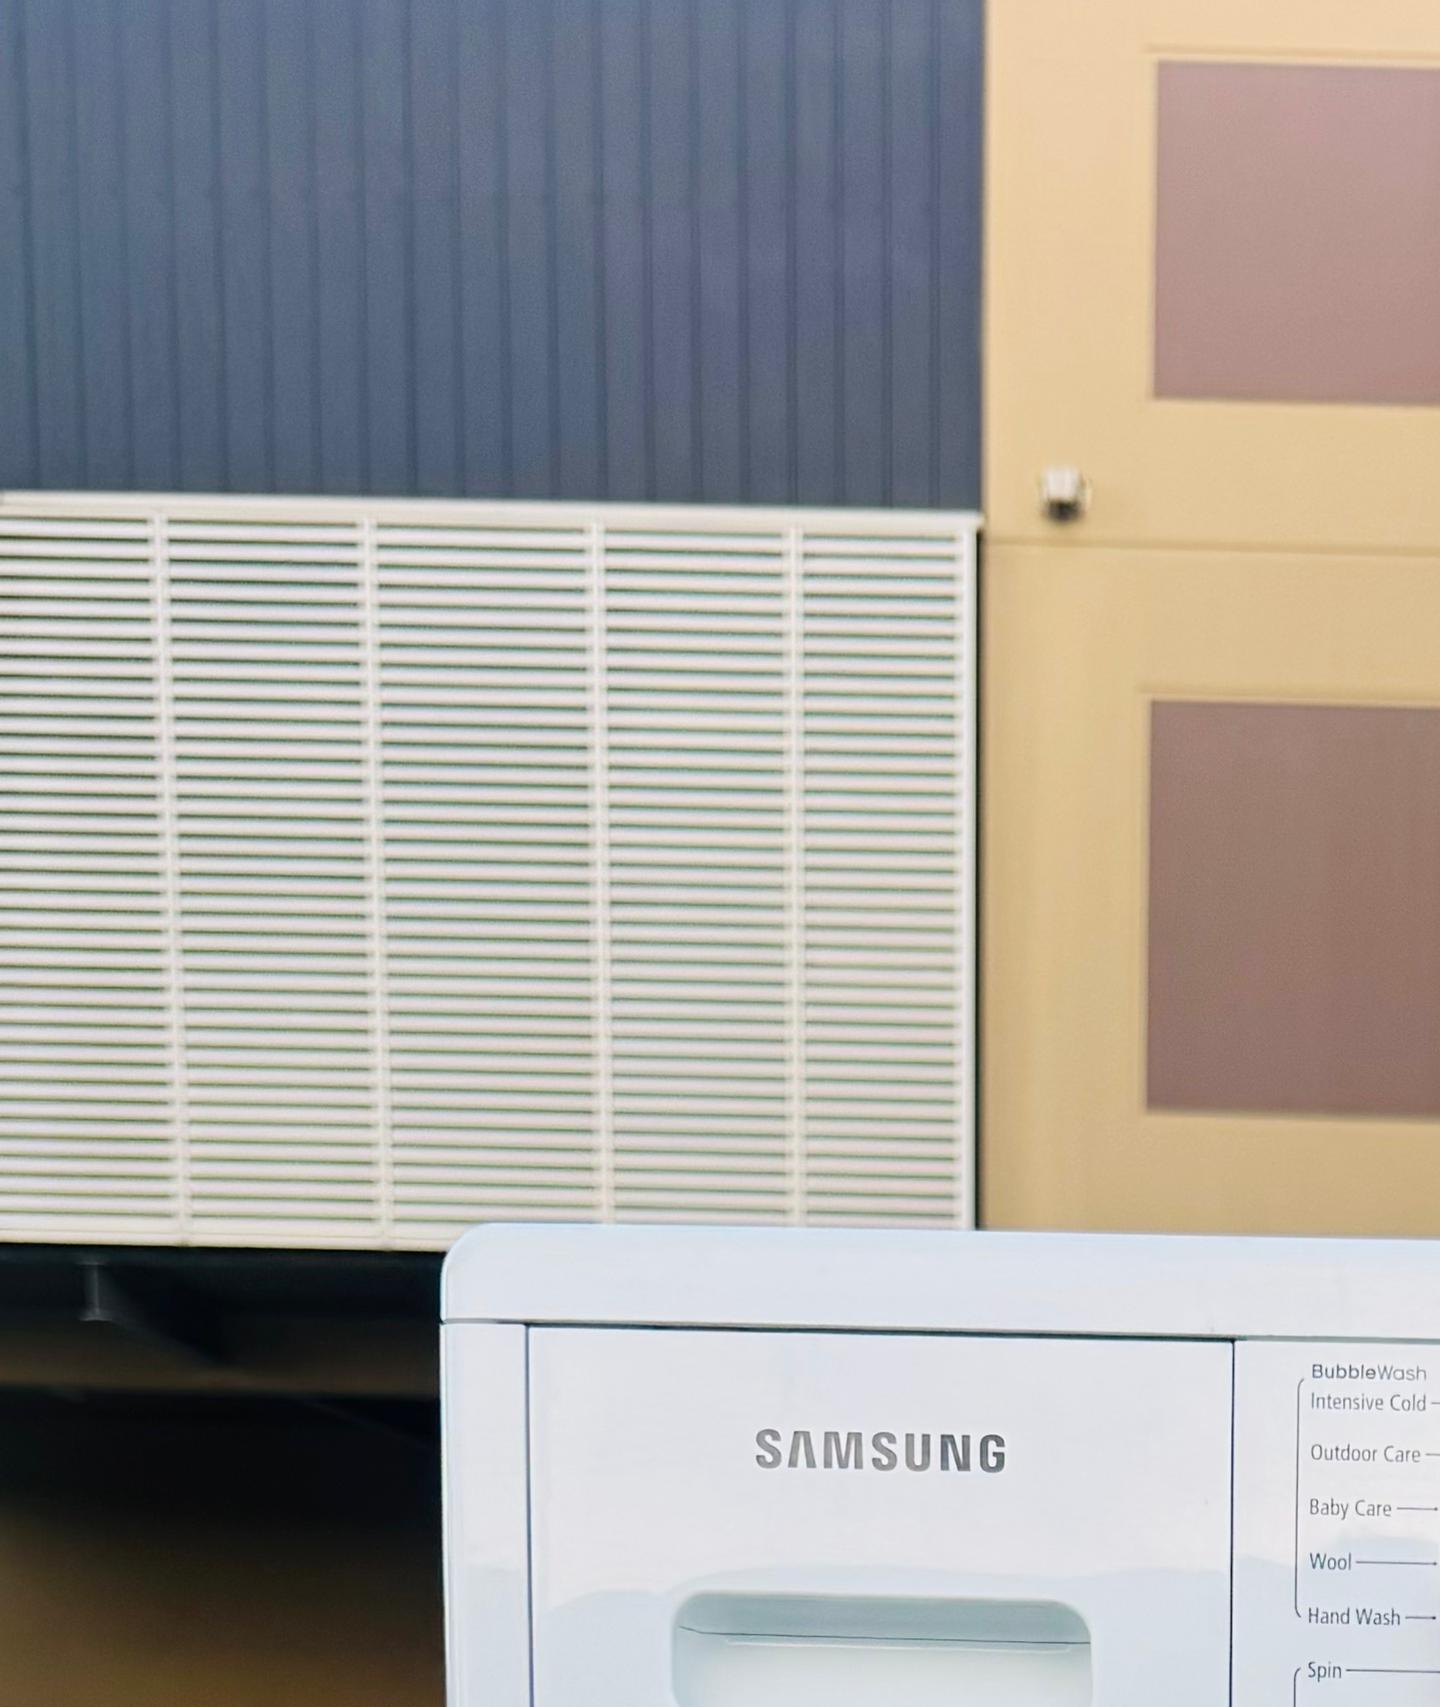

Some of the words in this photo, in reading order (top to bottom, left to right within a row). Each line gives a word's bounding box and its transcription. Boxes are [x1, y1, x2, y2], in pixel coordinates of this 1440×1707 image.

[1312, 1364, 1426, 1380] BubbleWash
[1312, 1392, 1383, 1410] Intensive
[1390, 1394, 1426, 1411] Cold
[756, 1429, 1005, 1473] SAMSUNG
[1311, 1444, 1377, 1461] Outdoor
[1384, 1445, 1420, 1463] Care
[1310, 1498, 1348, 1520] Baby
[1355, 1500, 1391, 1516] Care
[1310, 1553, 1351, 1570] Wool
[1309, 1608, 1350, 1624] Hand
[1356, 1608, 1400, 1625] Wash
[1308, 1662, 1341, 1682] Spin
